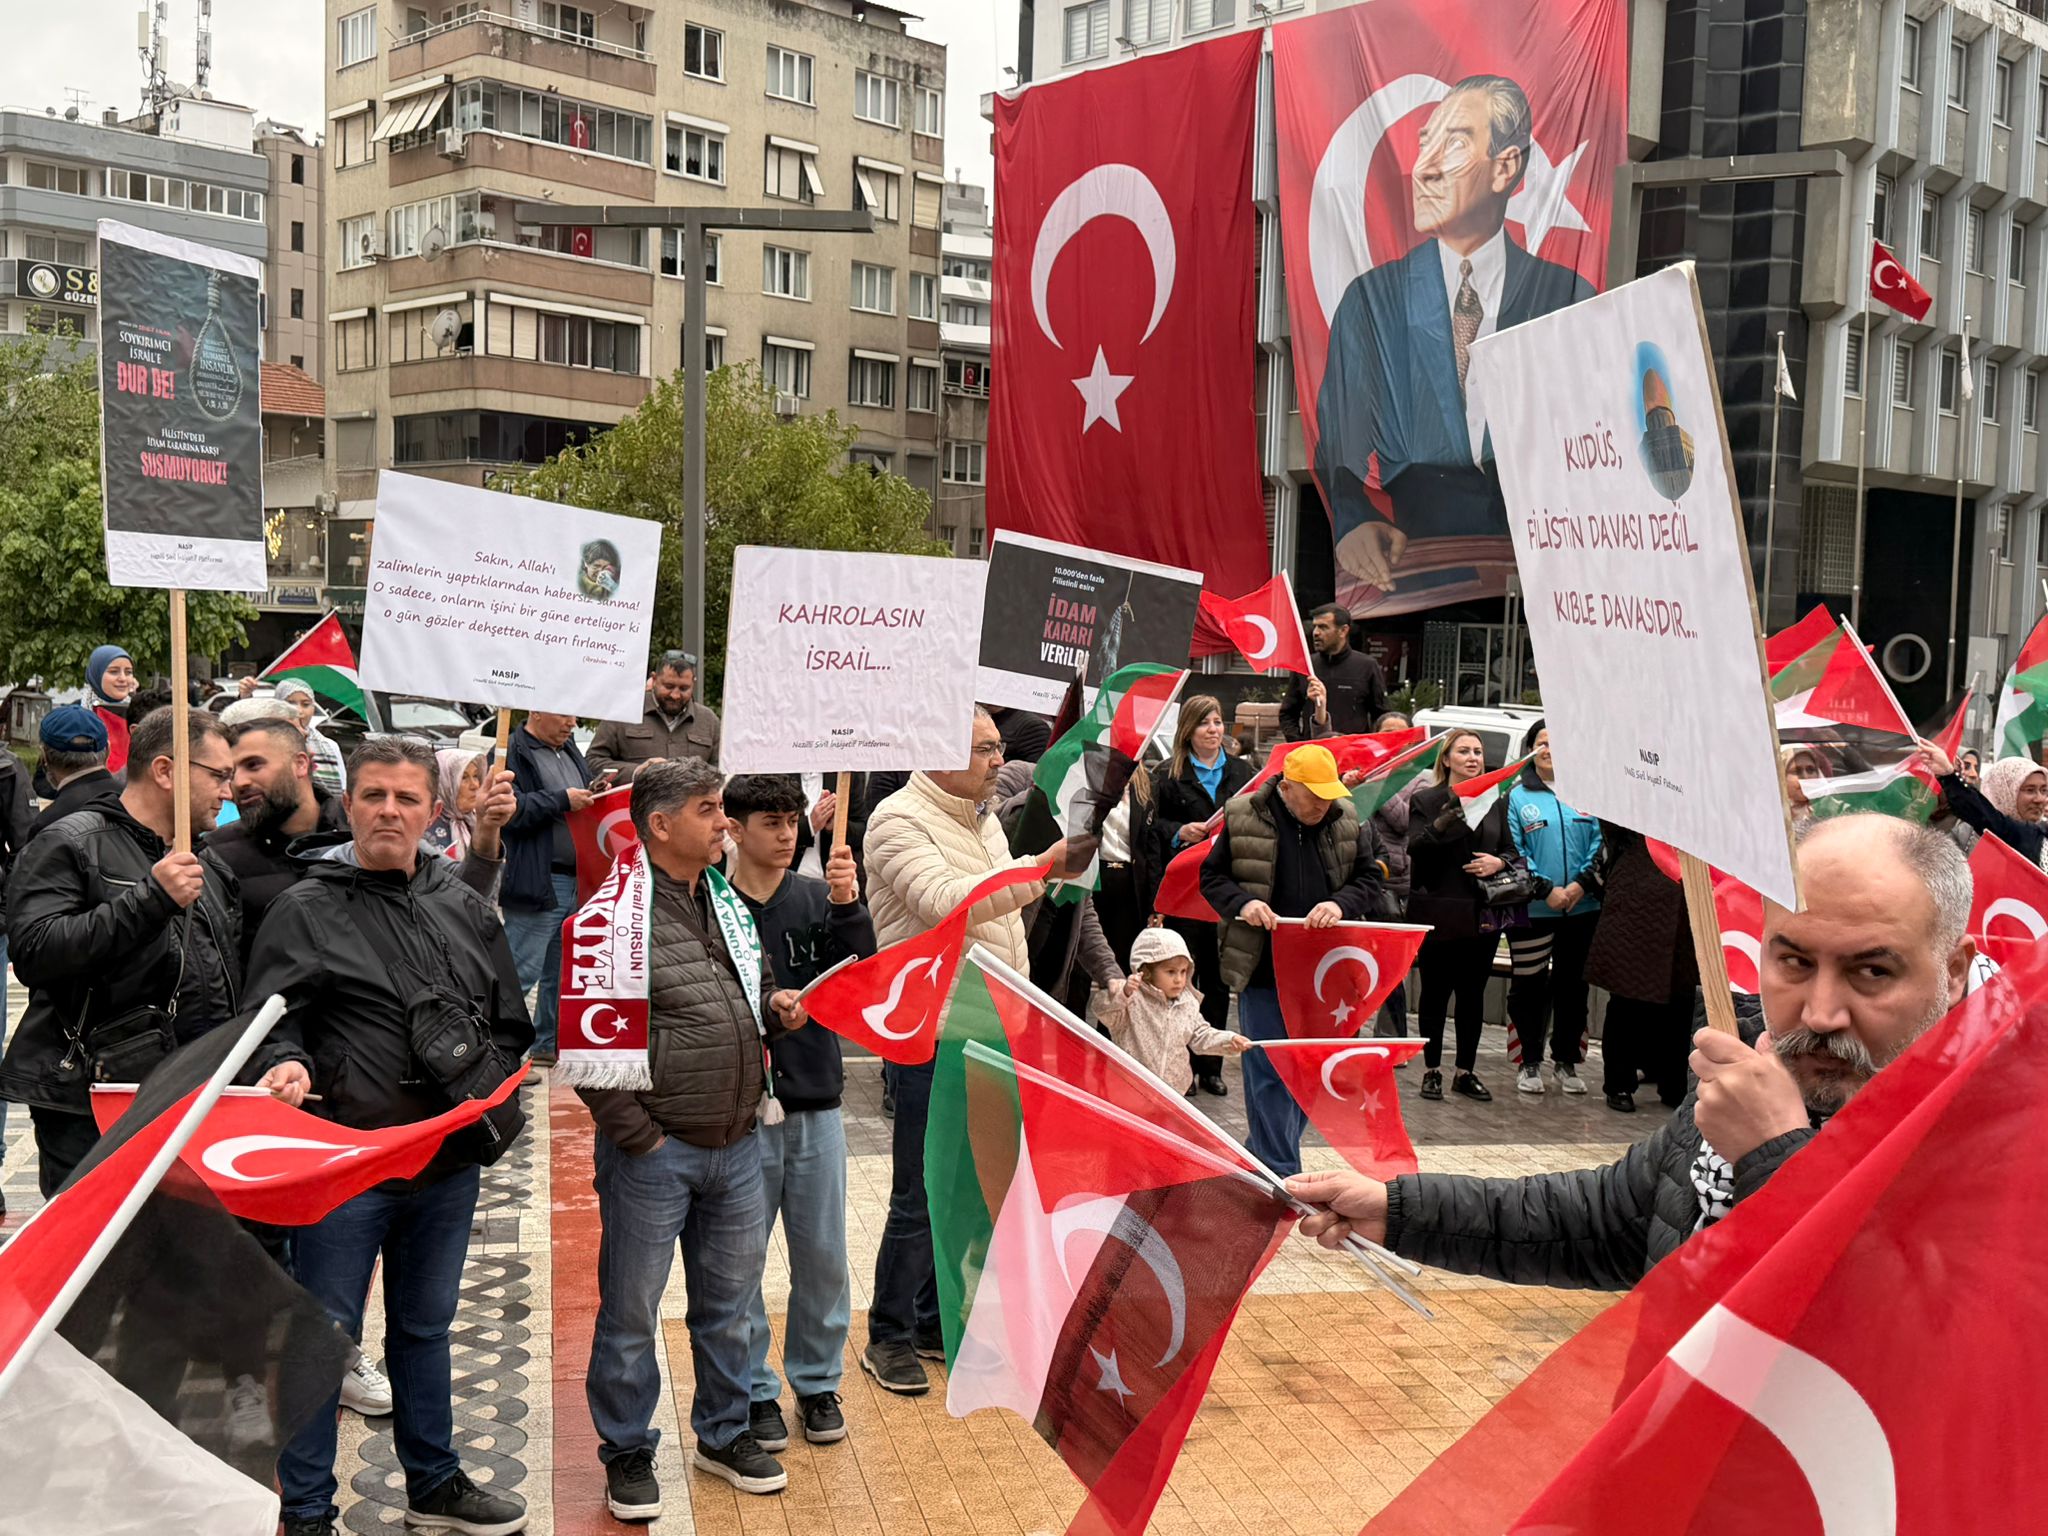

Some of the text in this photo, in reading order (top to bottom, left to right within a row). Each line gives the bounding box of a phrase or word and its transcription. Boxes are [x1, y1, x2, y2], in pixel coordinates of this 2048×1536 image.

[66, 268, 84, 291] S
[119, 330, 171, 352] SOYKIRIMCI
[117, 361, 148, 395] DUR
[151, 367, 175, 400] DE!
[1564, 421, 1622, 472] KUDÜS,
[140, 451, 228, 485] SUSMUYORUZ!
[1527, 500, 1699, 554] FİLİSTİN DAVASI DEĞİL
[376, 559, 442, 578] zalimlerin
[446, 572, 540, 595] yaptıklarından
[474, 551, 556, 575] Sakın, Allah'ı
[373, 581, 640, 633] O sadece, onların işini bir güne erteliyor ki
[778, 603, 925, 628] KAHROLASIN
[1047, 592, 1097, 625] İDAM
[1553, 591, 1597, 626] KIBLE
[384, 609, 392, 617] o
[395, 610, 421, 623] gün
[425, 614, 465, 629] gözler
[468, 620, 529, 639] dehşetten
[534, 630, 568, 645] dışarı
[1043, 619, 1093, 647] KARARI
[806, 644, 891, 670] İSRAİL...
[491, 669, 520, 680] NASİP
[831, 728, 854, 736] NASİP
[858, 739, 890, 747] Platformu
[630, 912, 643, 971] DURSUN
